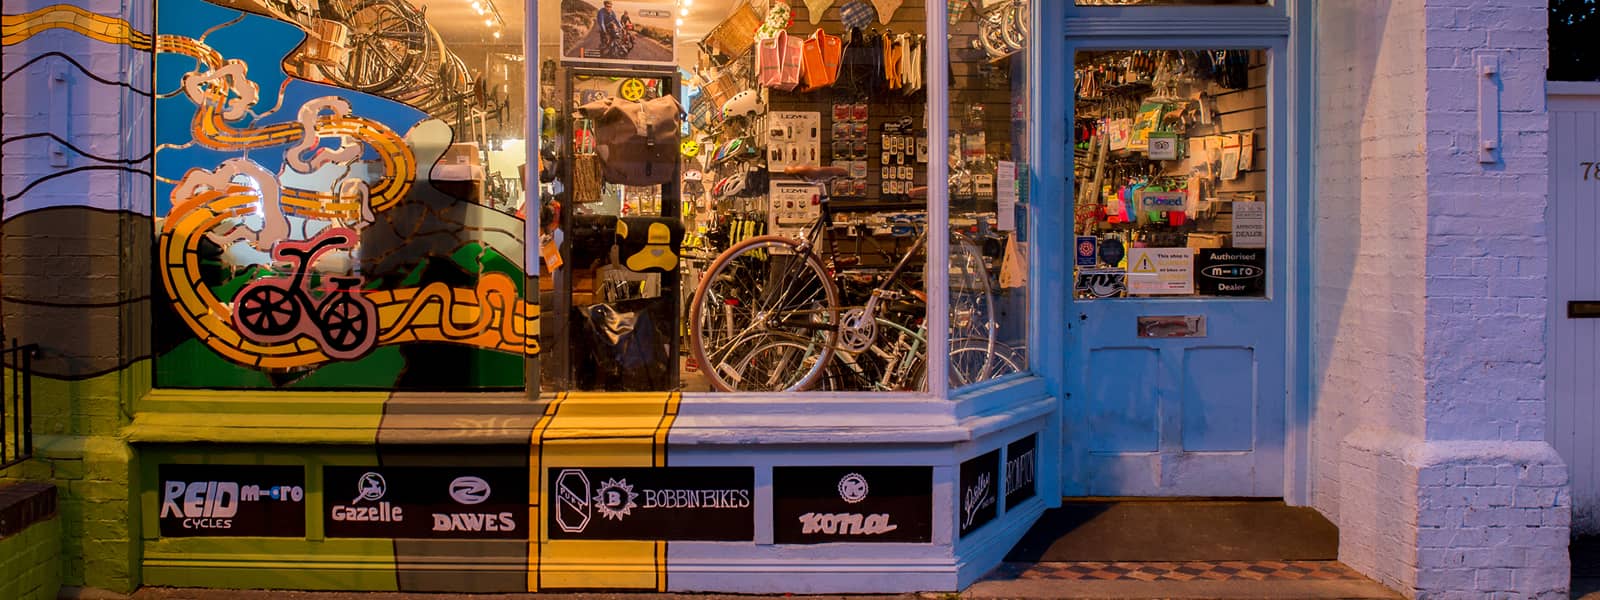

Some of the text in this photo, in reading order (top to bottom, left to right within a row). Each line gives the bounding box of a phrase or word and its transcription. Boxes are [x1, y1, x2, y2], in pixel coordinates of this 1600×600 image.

[1143, 195, 1183, 206] Closed
[1210, 252, 1257, 261] Authorised
[1218, 282, 1246, 291] Dealer
[160, 481, 239, 518] REID
[606, 491, 621, 506] B
[643, 489, 750, 508] BOBBIN BIKES
[331, 501, 403, 523] Gazelle
[183, 519, 232, 529] CYCLES
[431, 512, 516, 532] DAWES
